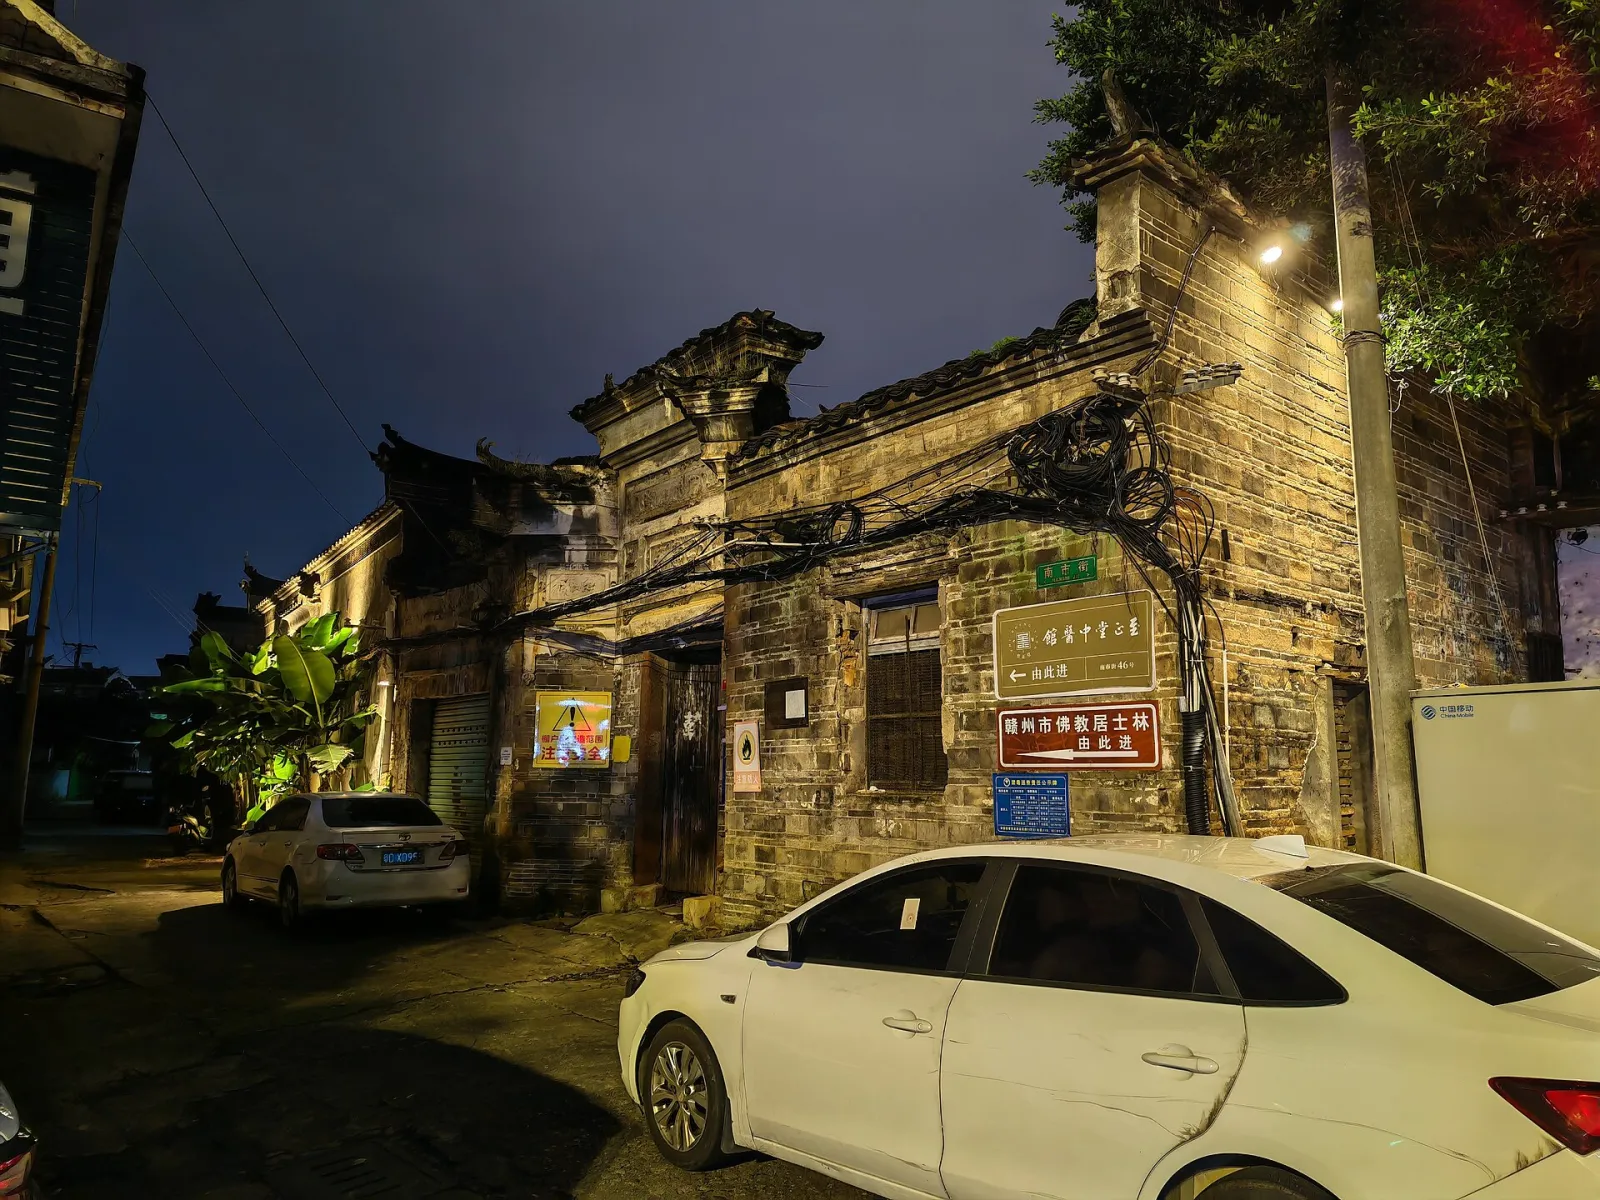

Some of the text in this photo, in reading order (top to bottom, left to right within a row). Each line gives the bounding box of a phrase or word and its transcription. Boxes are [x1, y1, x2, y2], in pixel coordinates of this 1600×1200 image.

[1044, 560, 1089, 578] 南市街
[1032, 663, 1068, 681] 由此进
[1439, 704, 1474, 712] 中国移动
[1004, 711, 1150, 735] 赣州市佛教居士林
[1078, 735, 1133, 750] 由此进
